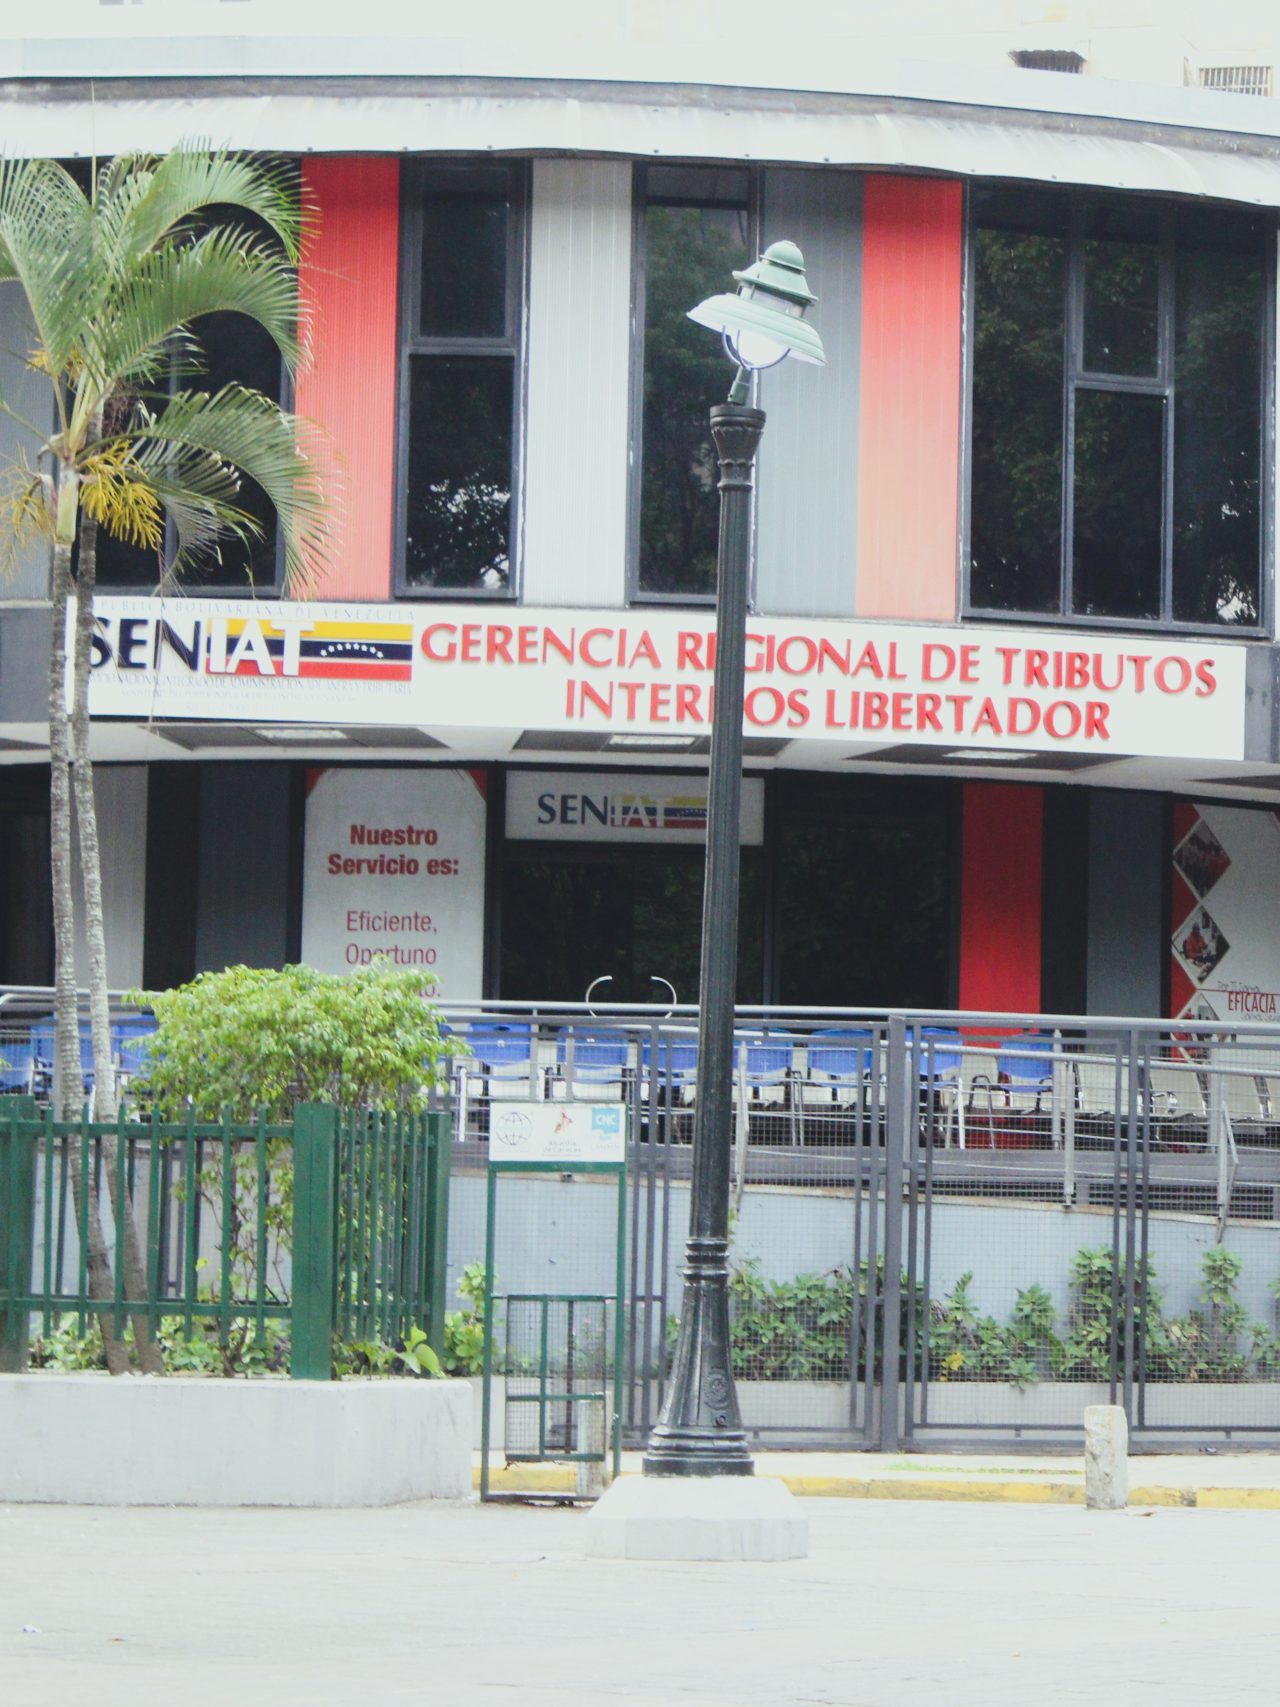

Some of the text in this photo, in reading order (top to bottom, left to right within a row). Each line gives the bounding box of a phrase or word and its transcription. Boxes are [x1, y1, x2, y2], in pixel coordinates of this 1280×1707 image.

[420, 622, 662, 669] GERENCIA
[921, 642, 981, 683] DE
[995, 646, 1218, 698] TRIBUTOS
[565, 678, 1111, 740] INTEROS LIBERTADOR
[537, 793, 671, 828] SENIAT
[349, 824, 438, 846] Nuestro
[328, 853, 460, 876] Servicio es:
[346, 910, 438, 935] Eficiente,
[1228, 991, 1277, 1013] EFICACIA
[595, 1114, 616, 1125] CNC
